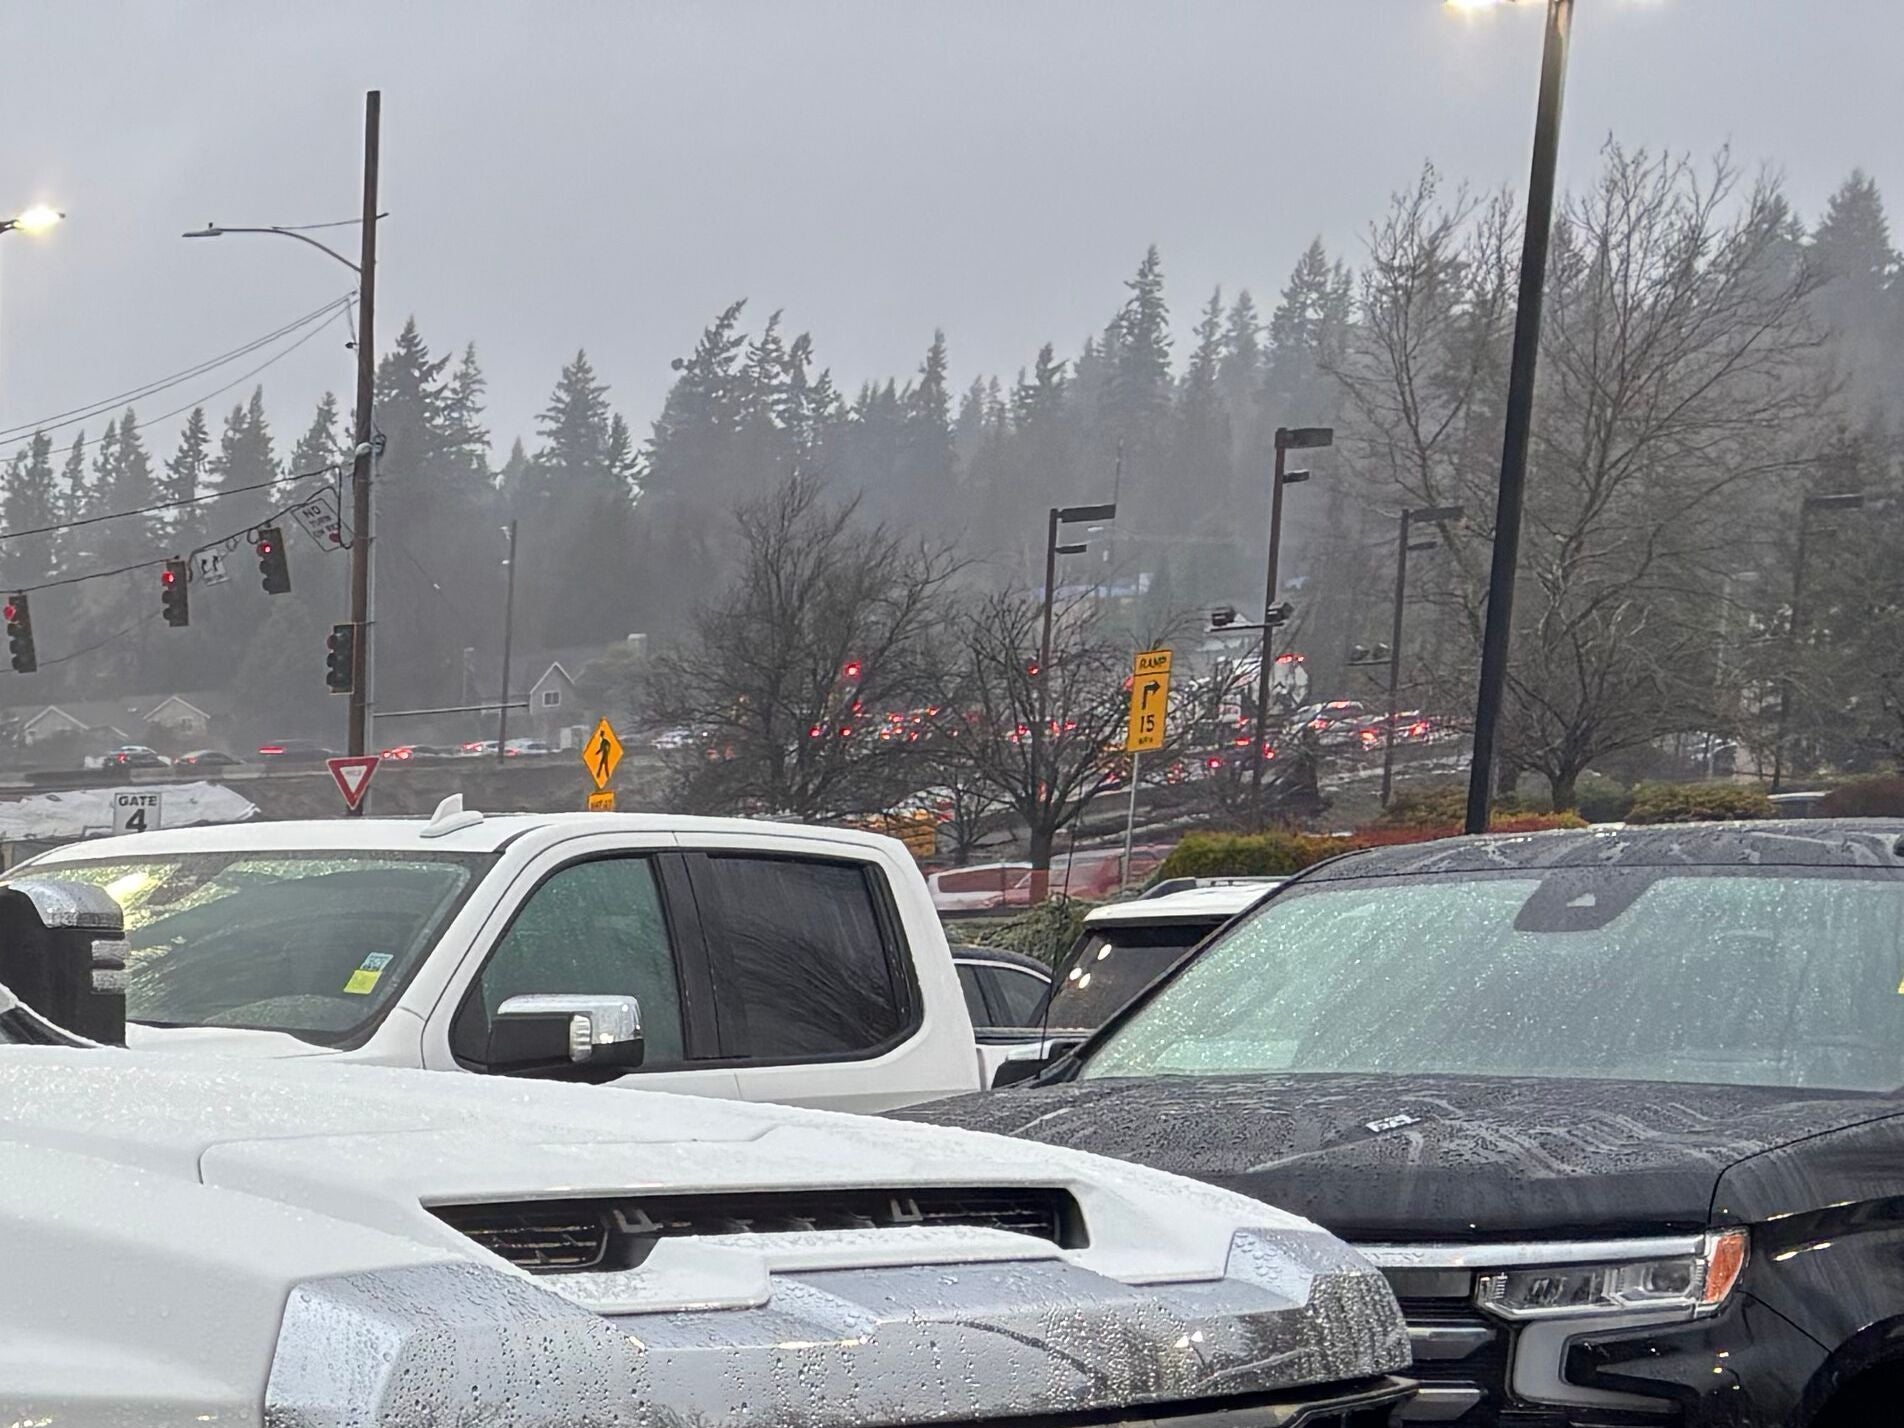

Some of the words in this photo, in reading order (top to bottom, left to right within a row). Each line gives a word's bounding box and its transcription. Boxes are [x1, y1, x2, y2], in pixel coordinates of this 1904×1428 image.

[1140, 714, 1155, 733] 15
[118, 795, 157, 807] GATE
[125, 808, 148, 832] 4
